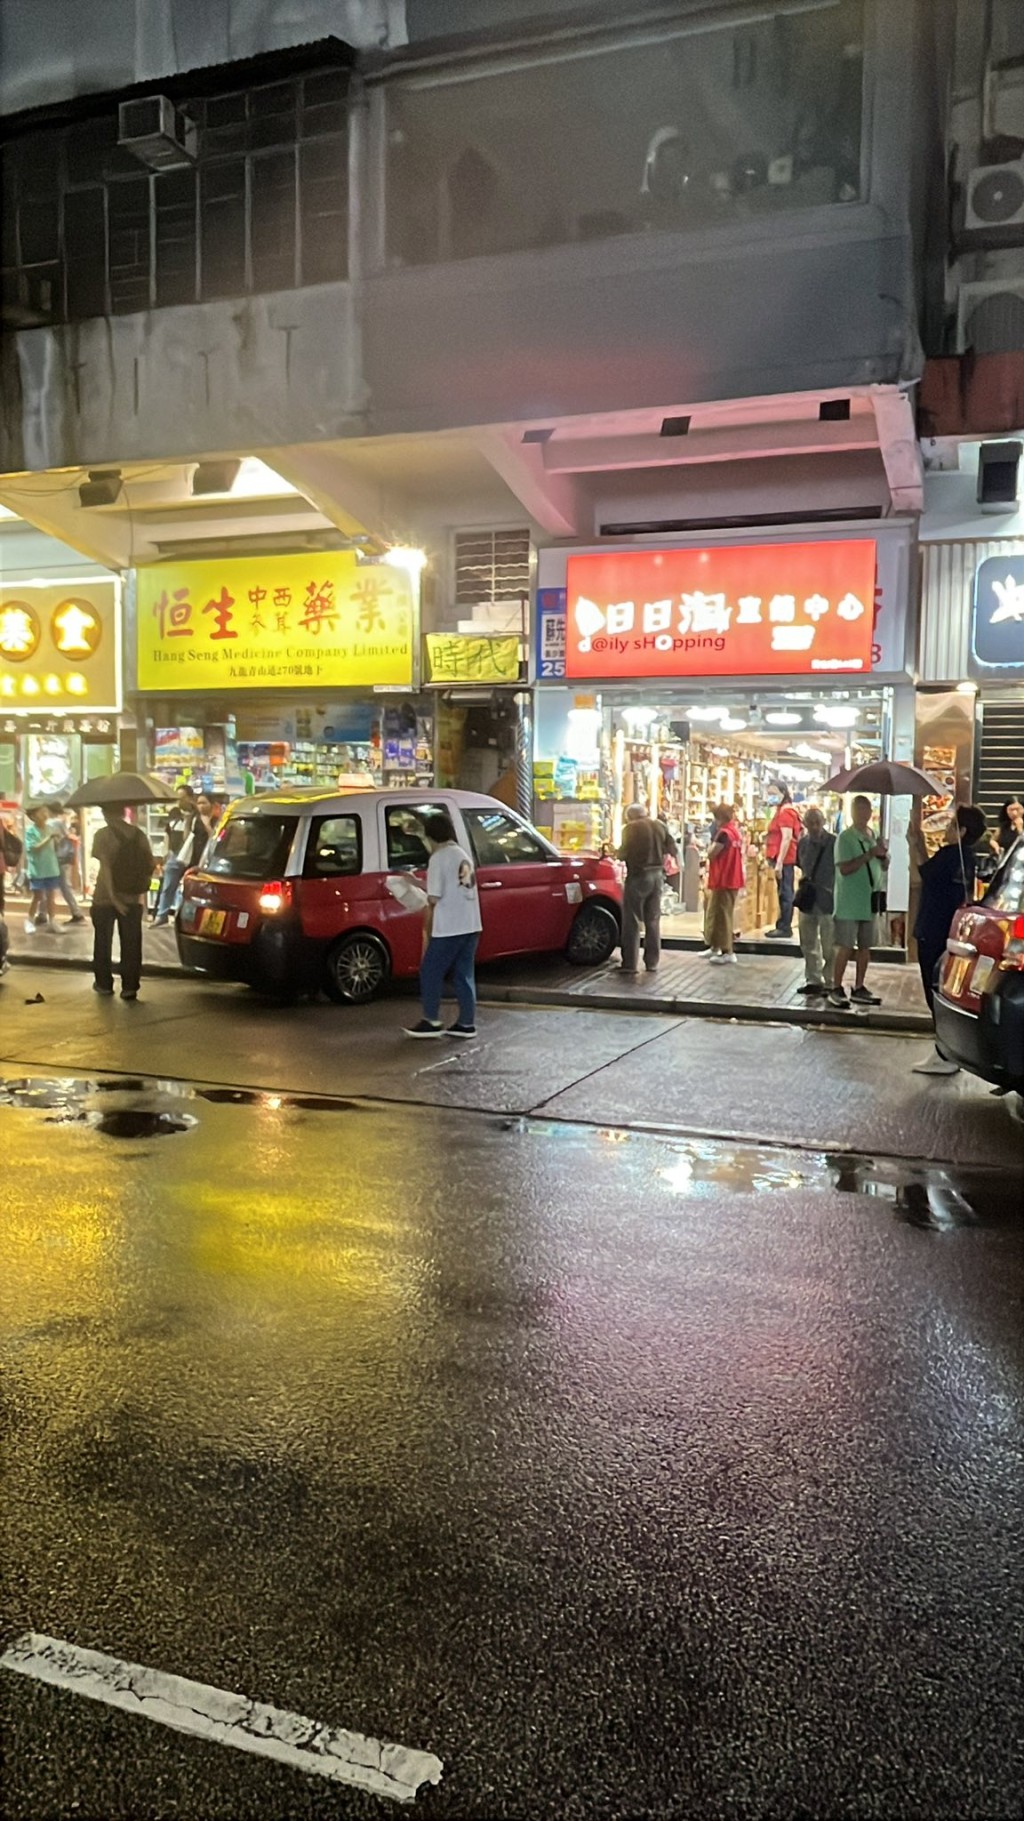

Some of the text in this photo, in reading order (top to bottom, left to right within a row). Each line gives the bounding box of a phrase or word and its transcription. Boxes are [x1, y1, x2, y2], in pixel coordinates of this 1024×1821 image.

[247, 586, 292, 610] 中西
[153, 587, 238, 640] 恒生
[153, 643, 407, 663] Hang Seng Medicine Company Limited
